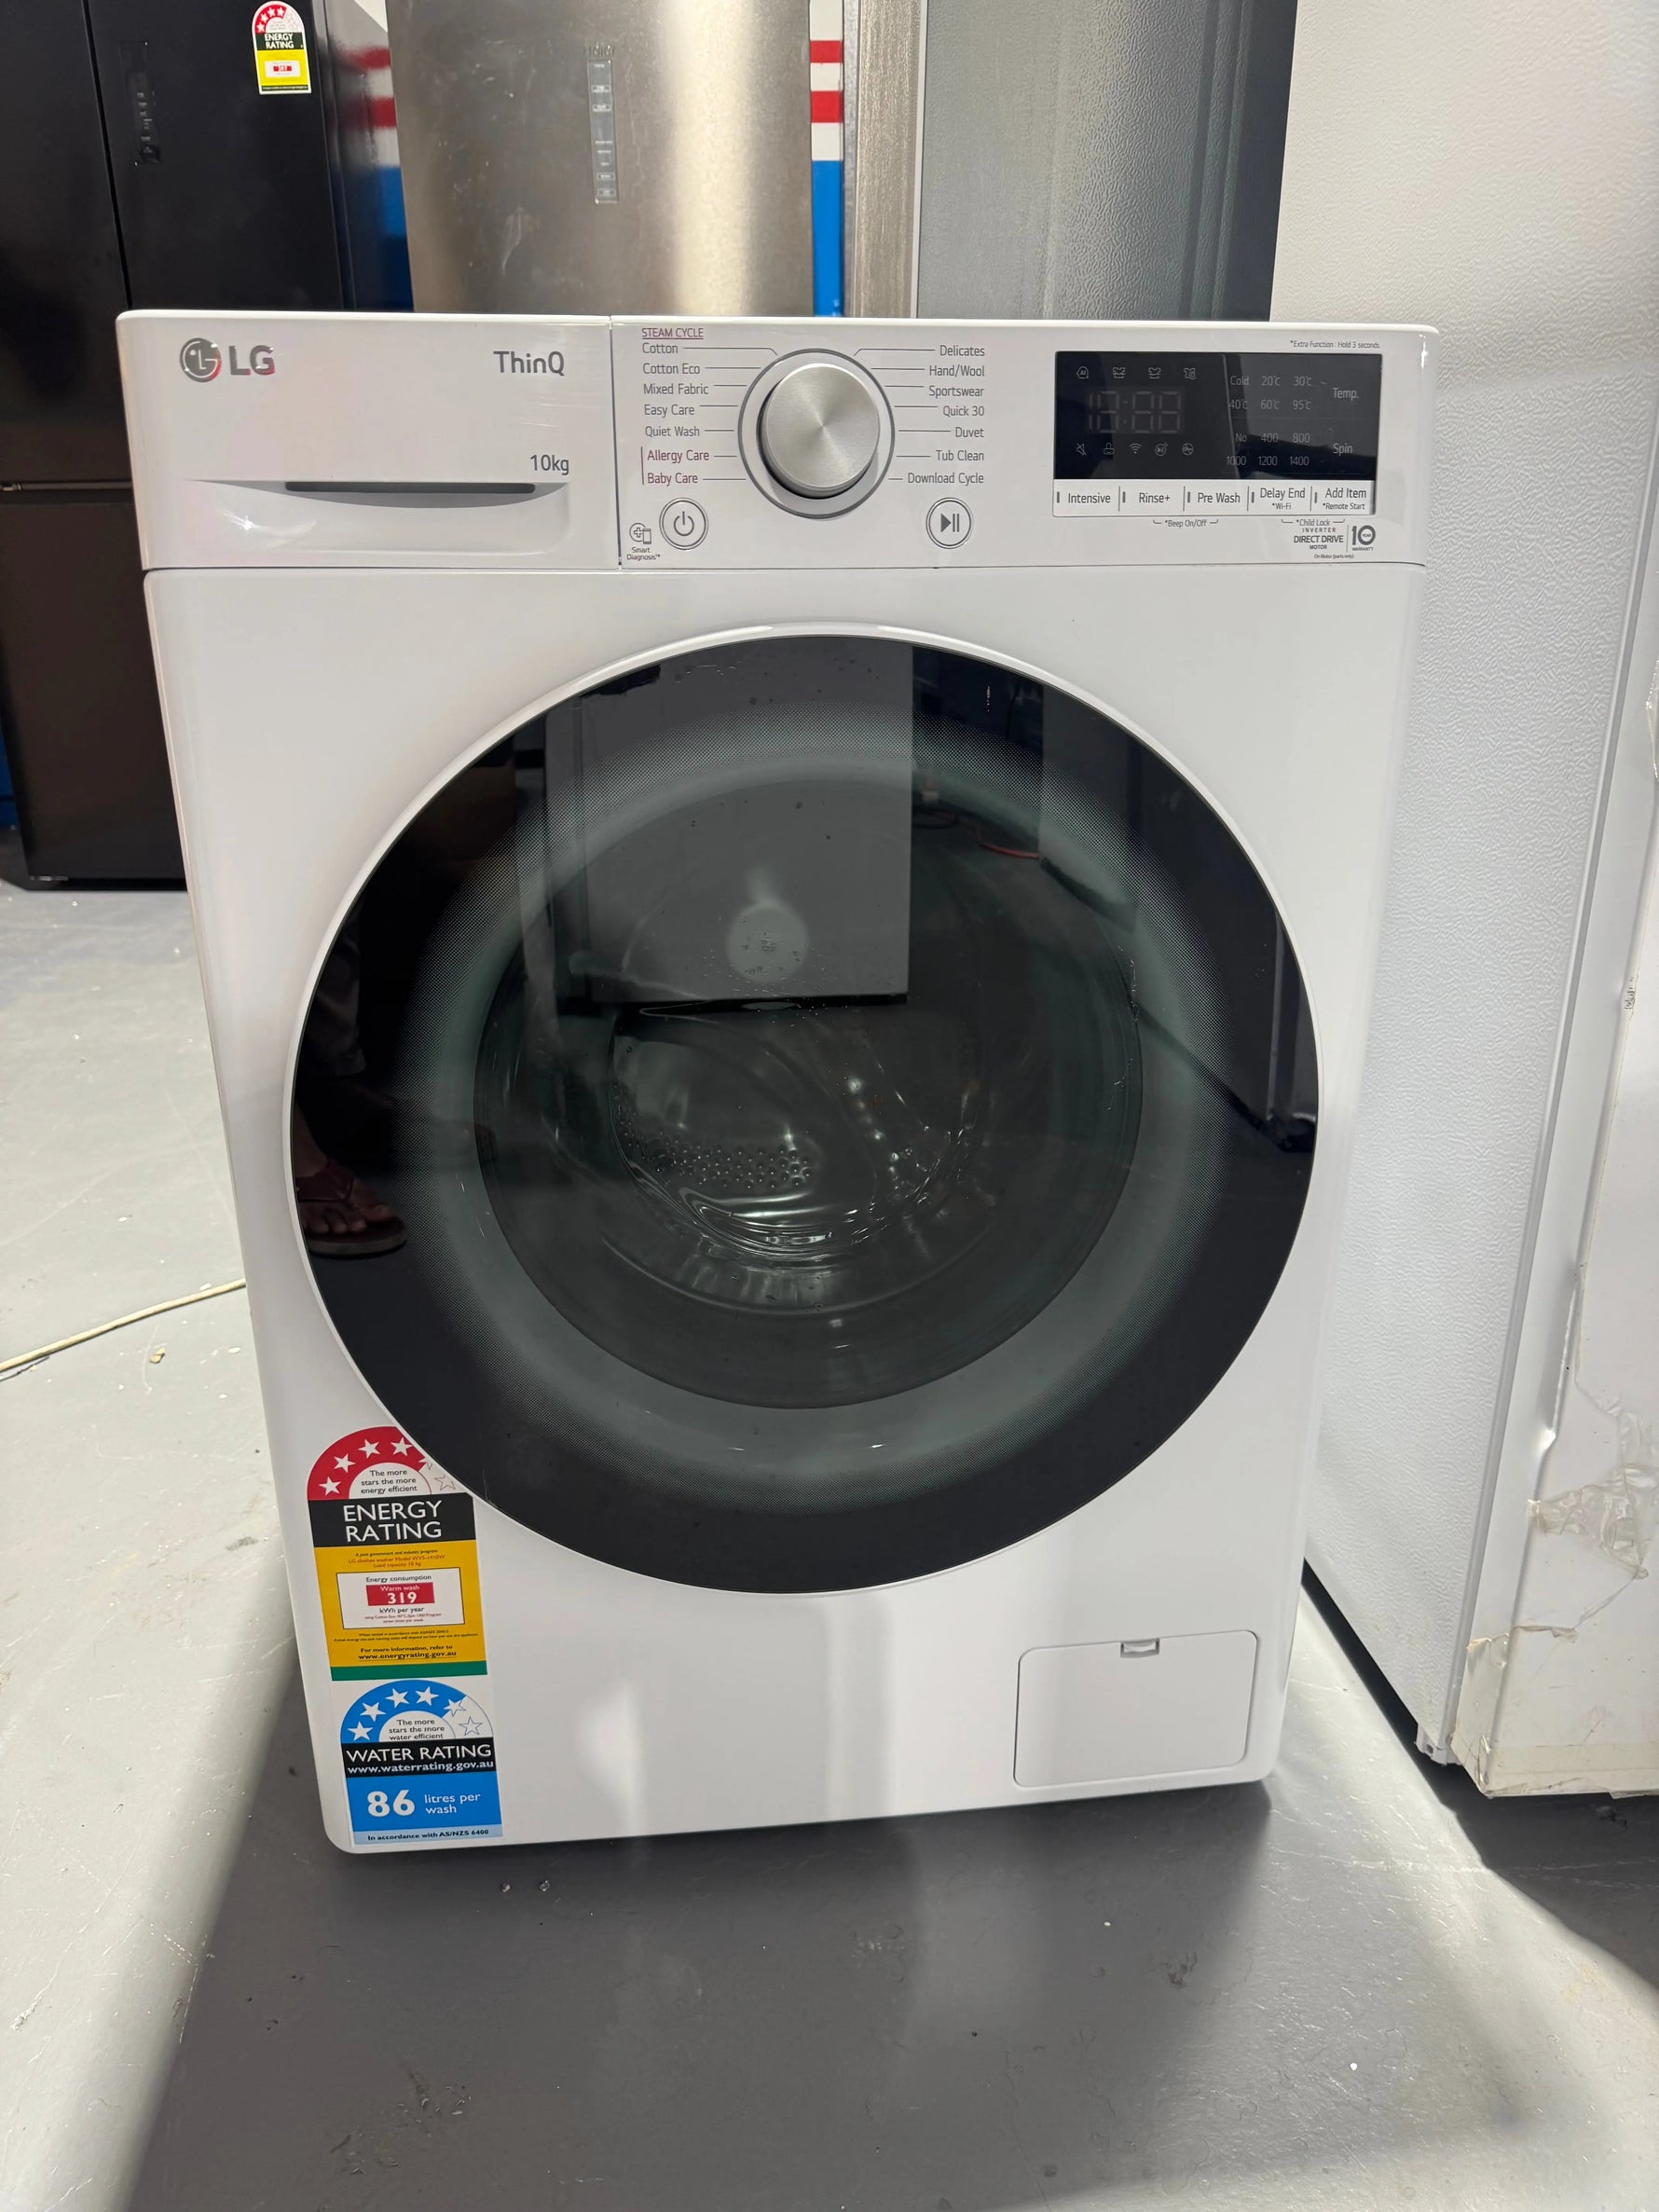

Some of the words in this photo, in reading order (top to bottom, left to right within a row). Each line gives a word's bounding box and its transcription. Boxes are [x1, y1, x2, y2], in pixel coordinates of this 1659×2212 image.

[266, 41, 294, 49] RATING
[641, 328, 673, 337] STEAM
[676, 328, 705, 337] CYCLE
[642, 342, 679, 354] Cotton
[939, 345, 985, 356] Delicates
[228, 345, 276, 376] LG
[493, 350, 565, 377] ThinQ
[642, 363, 679, 374] Cotton
[681, 363, 701, 374] Eco
[929, 364, 985, 378] Hand/Wool
[1230, 376, 1250, 386] Cold
[643, 383, 674, 394] Mixed
[678, 383, 709, 394] Fabric
[928, 385, 984, 399] Sportswear
[1332, 387, 1360, 401] Temp.
[644, 404, 668, 419] Easy
[671, 404, 695, 416] Care
[942, 405, 969, 418] Quick
[971, 405, 985, 417] 30
[645, 426, 672, 437] Quiet
[674, 426, 700, 437] Wash
[955, 426, 985, 438] Duvet
[1235, 433, 1248, 443] No
[1261, 433, 1279, 443] 400
[1292, 433, 1310, 443] 800
[935, 449, 954, 461] Tub
[957, 449, 984, 461] Clean
[1333, 443, 1352, 457] Spin
[647, 449, 683, 464] Allergy
[686, 449, 710, 461] Care
[1227, 456, 1247, 466] 1000
[1258, 456, 1278, 466] 1200
[1290, 456, 1309, 466] 1400
[529, 454, 569, 475] 10kg
[647, 472, 672, 487] Baby
[675, 472, 699, 484] Care
[908, 472, 955, 484] Download
[958, 472, 984, 487] Cycle
[1068, 492, 1111, 503] Intensive
[1138, 492, 1171, 503] Rinse+
[1197, 492, 1213, 503] Pre
[1215, 492, 1241, 503] Wash
[1260, 488, 1285, 501] Delay
[1288, 488, 1306, 499] End
[1324, 488, 1343, 499] Add
[1346, 488, 1366, 499] Item
[1185, 519, 1207, 528] On/Off
[1294, 535, 1320, 543] DIRECT
[1321, 535, 1344, 543] DRIVE
[1351, 525, 1376, 545] 10
[343, 1500, 443, 1522] ENERGY
[345, 1521, 442, 1543] RATING
[390, 1574, 432, 1583] consumption
[388, 1592, 418, 1604] 319
[358, 1651, 457, 1660] www.energyrating.gov.au
[347, 1748, 415, 1763] WATER
[419, 1744, 492, 1761] RATING
[347, 1761, 494, 1774] www.waterrating.gov.au
[366, 1789, 416, 1818] 86
[424, 1793, 455, 1804] litres
[459, 1793, 481, 1805] per
[425, 1804, 457, 1814] wash
[377, 1833, 419, 1841] accordance
